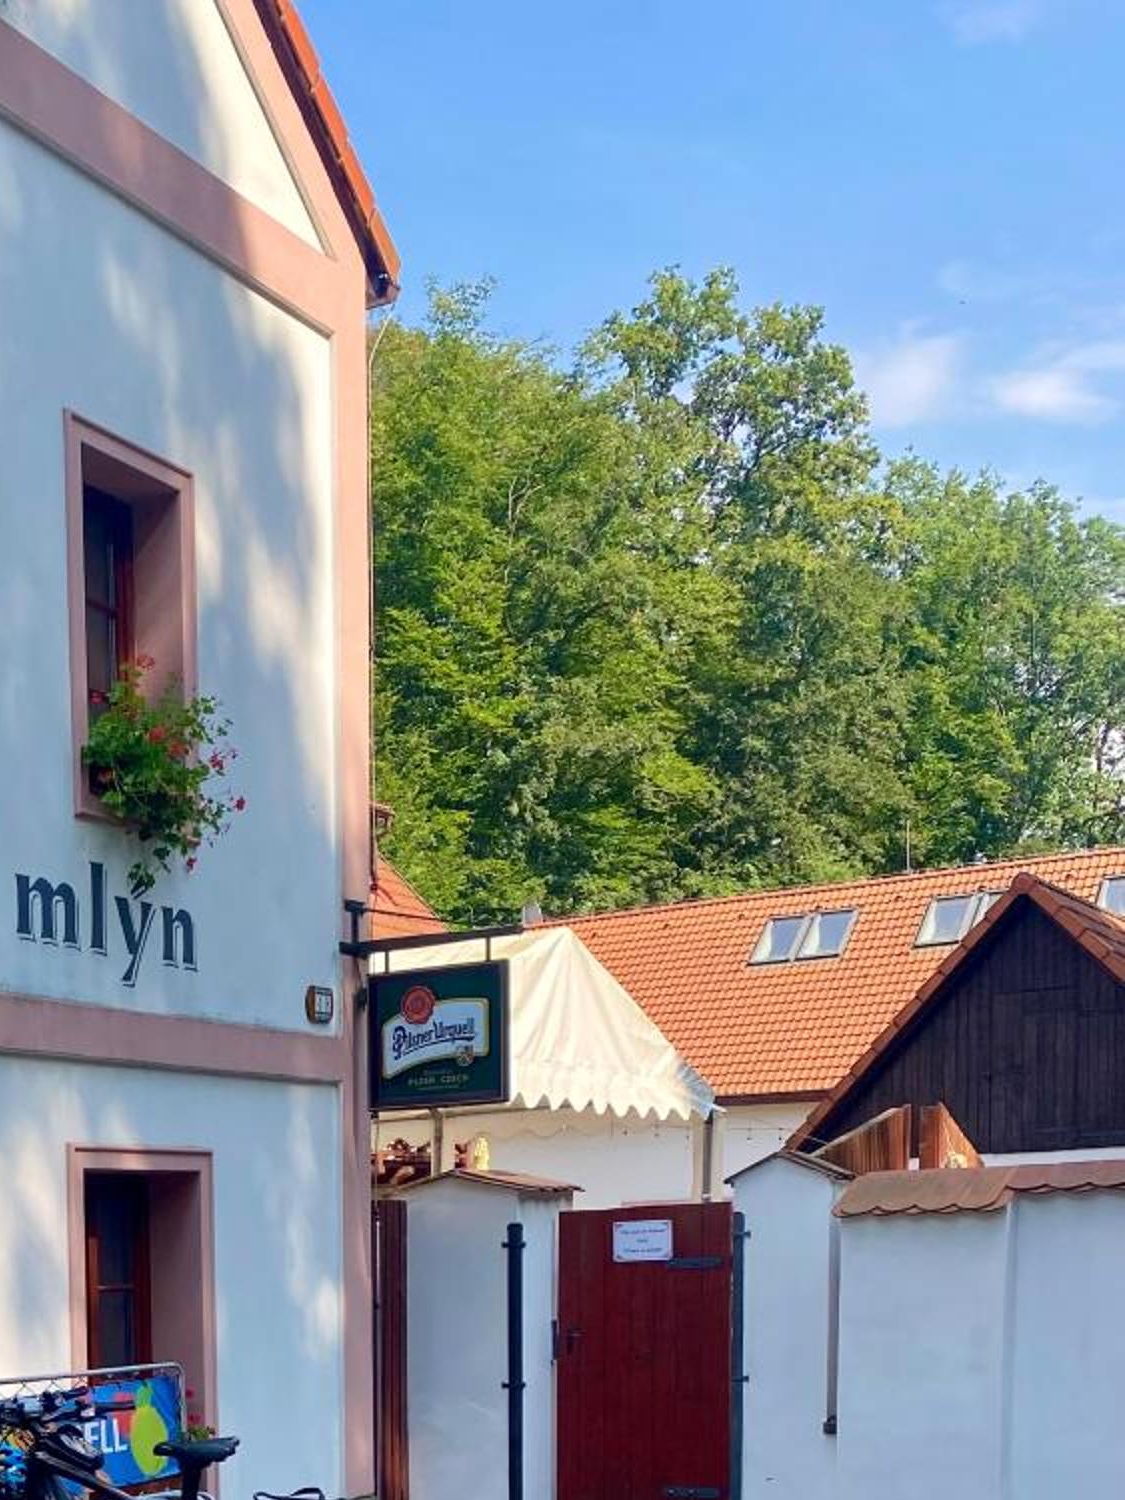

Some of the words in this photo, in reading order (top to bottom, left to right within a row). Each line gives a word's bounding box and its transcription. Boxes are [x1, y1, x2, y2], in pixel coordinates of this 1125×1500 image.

[14, 862, 198, 990] mlýn
[392, 1025, 433, 1061] Pilsner
[432, 1017, 475, 1042] Urquell
